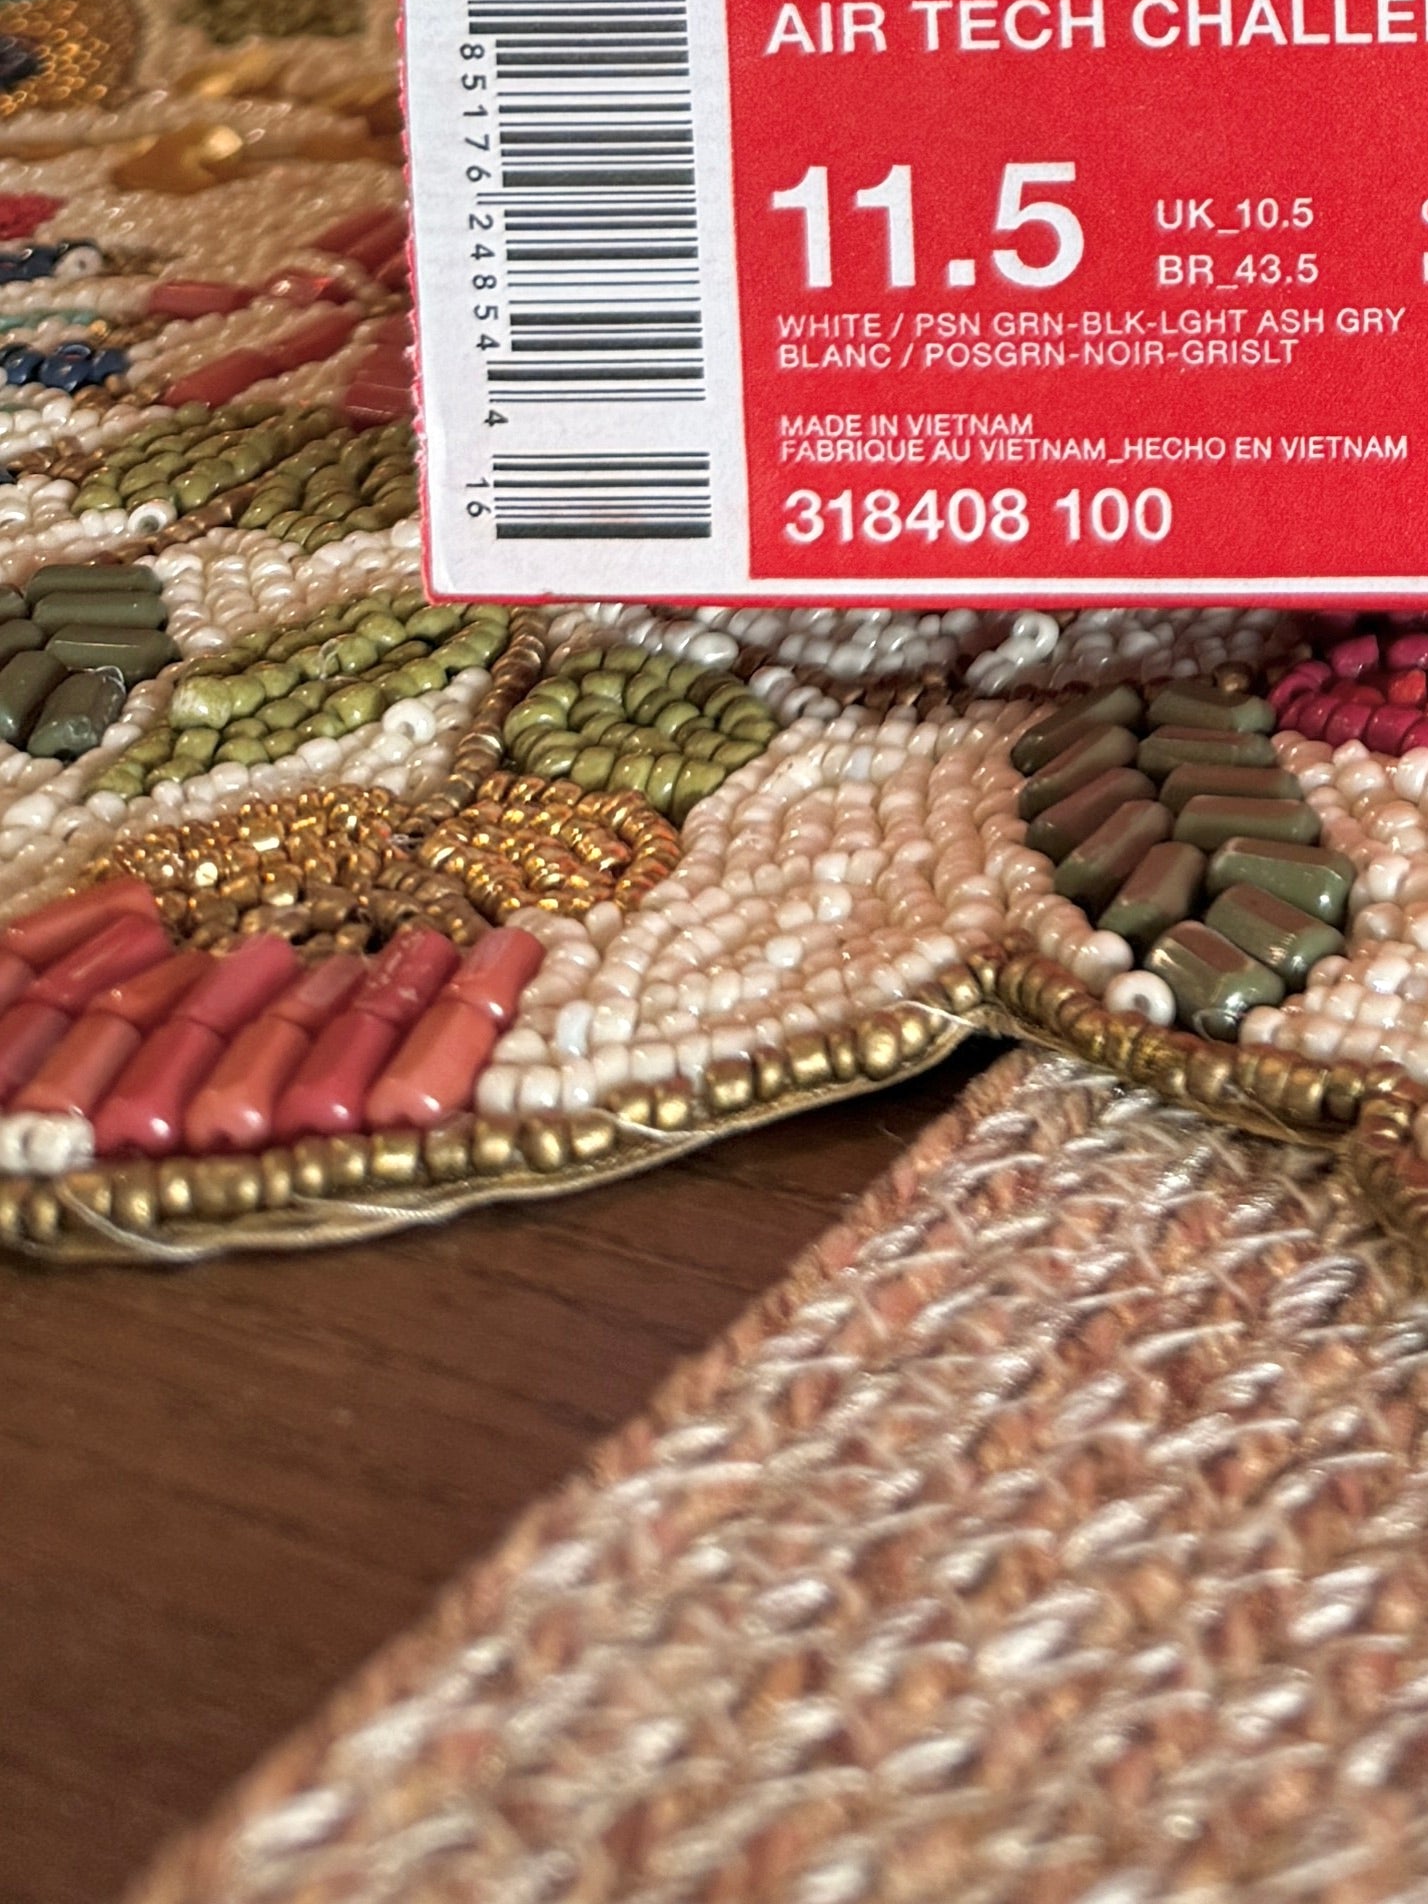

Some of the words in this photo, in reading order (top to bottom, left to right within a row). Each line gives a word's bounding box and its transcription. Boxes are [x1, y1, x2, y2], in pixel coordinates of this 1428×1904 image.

[763, 1, 888, 56] AIR
[770, 161, 1085, 290] 11.5
[1156, 197, 1314, 235] UK_10.5
[1157, 253, 1319, 291] BR_43.5
[778, 313, 881, 338] WHITE
[890, 313, 905, 339] /
[915, 312, 981, 338] PSN
[992, 308, 1248, 337] GRN-BLK-LGHT
[1257, 308, 1325, 334] ASH
[1336, 307, 1406, 334] GRY
[778, 343, 892, 369] BLANC
[900, 343, 914, 369] /
[924, 339, 1299, 368] POSGRN-NOIR-GRISLT
[780, 414, 863, 438] MADE
[870, 414, 899, 436] IN
[906, 413, 1033, 436] VIETNAM
[780, 438, 926, 464] FABRIQUE
[930, 438, 971, 462] AU
[978, 436, 1226, 464] VIETNAM_HECHO
[1234, 436, 1272, 460] EN
[1280, 435, 1408, 460] VIETNAM
[783, 487, 1030, 545] 318408
[1054, 487, 1173, 544] 100
